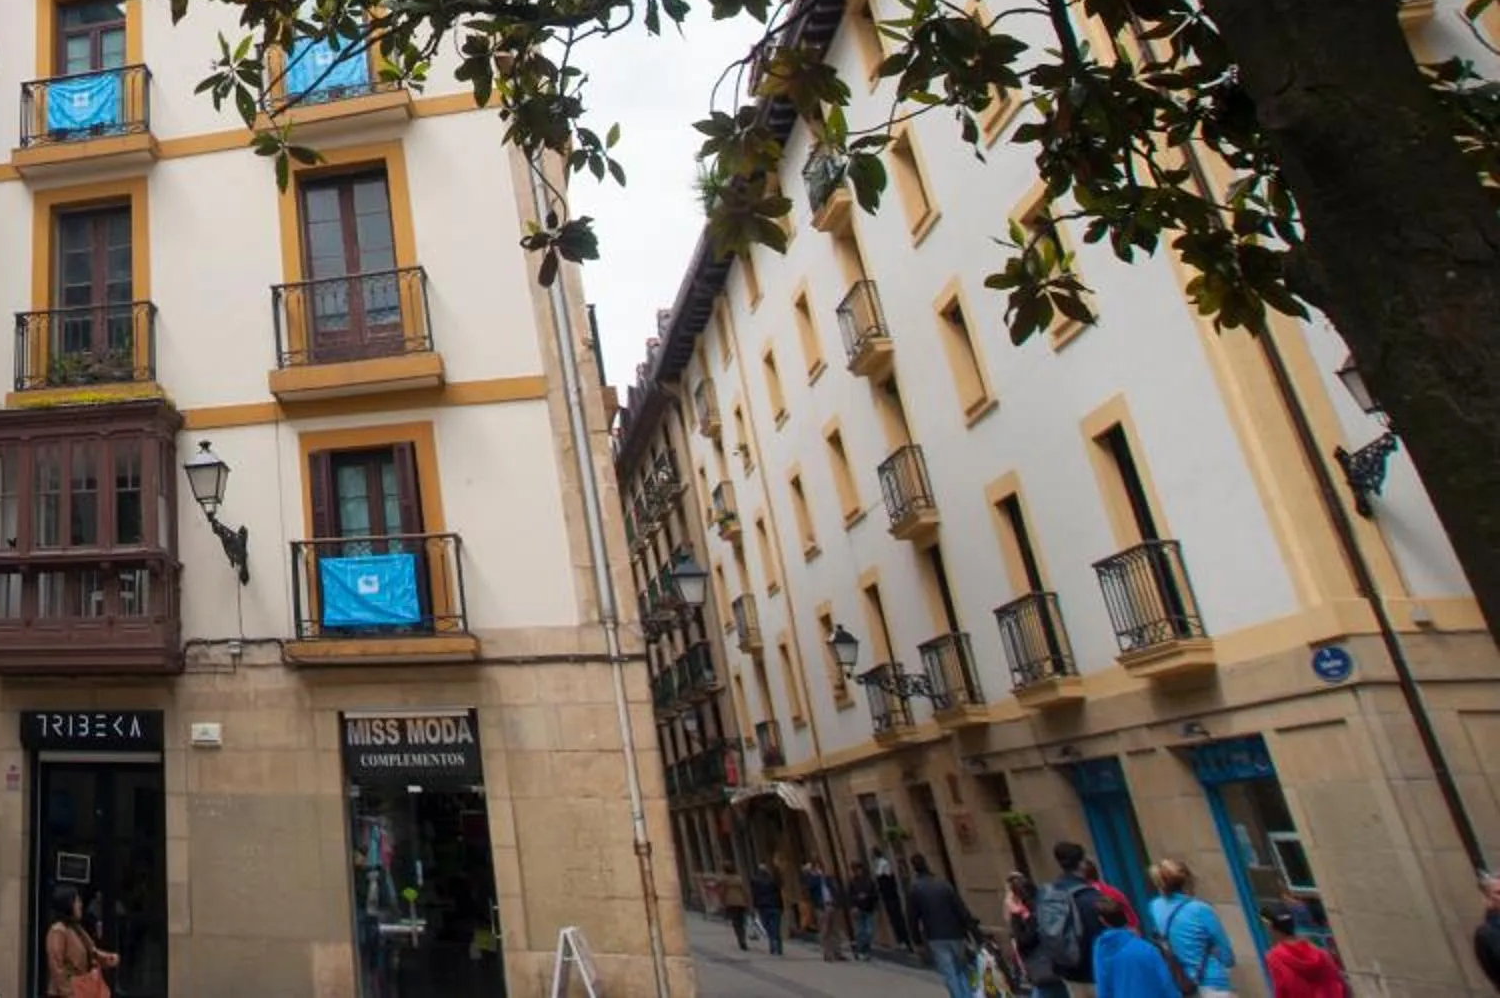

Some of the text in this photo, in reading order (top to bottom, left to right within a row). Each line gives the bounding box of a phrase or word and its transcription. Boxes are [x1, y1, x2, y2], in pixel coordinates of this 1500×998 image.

[346, 715, 474, 745] MISS MODA
[359, 752, 466, 768] COMPLEMENTOS
